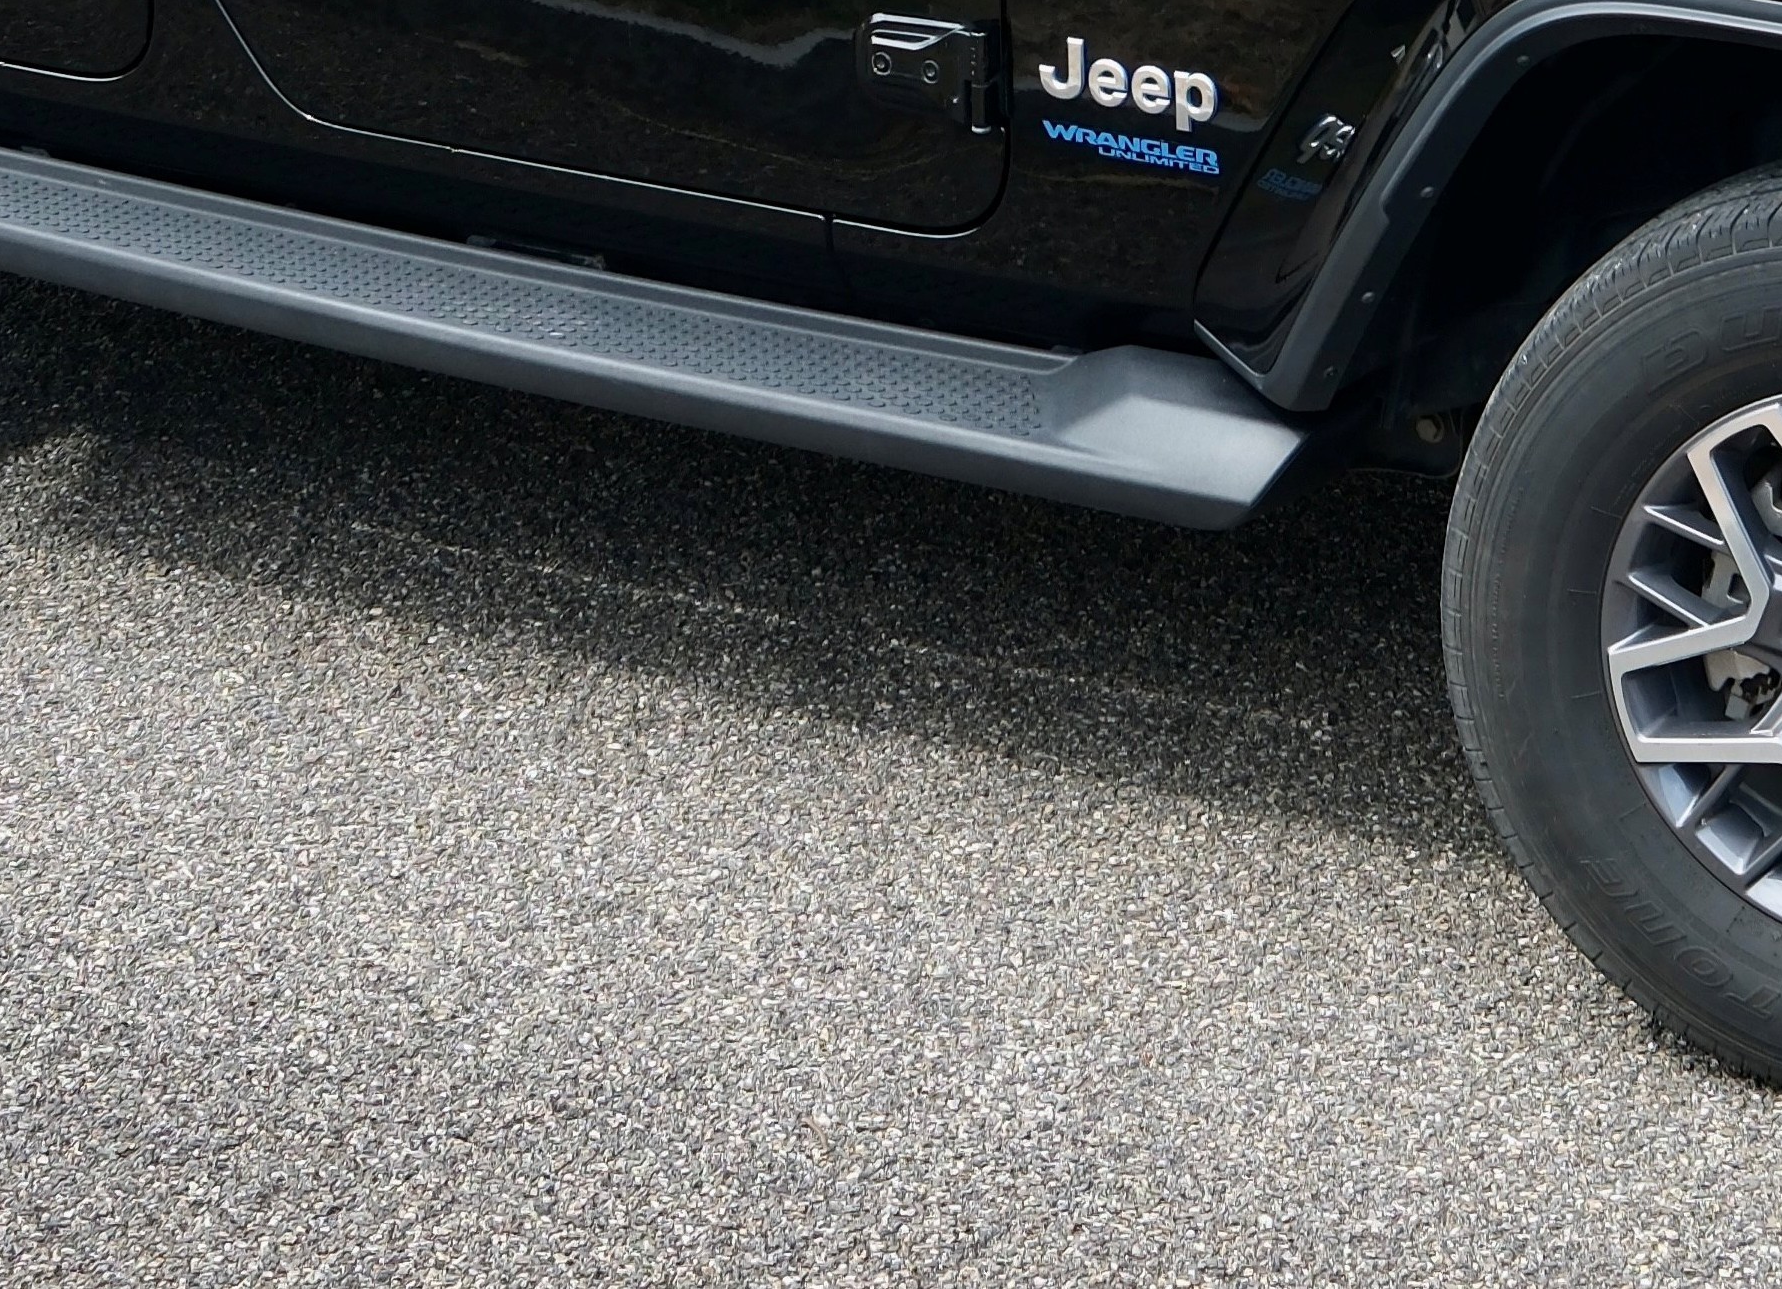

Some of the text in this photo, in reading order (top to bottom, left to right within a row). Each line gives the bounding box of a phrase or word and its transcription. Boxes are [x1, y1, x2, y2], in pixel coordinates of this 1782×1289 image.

[1039, 36, 1218, 132] Jeep
[1042, 120, 1218, 166] WRANGLER
[1098, 146, 1220, 174] UNLIMITED
